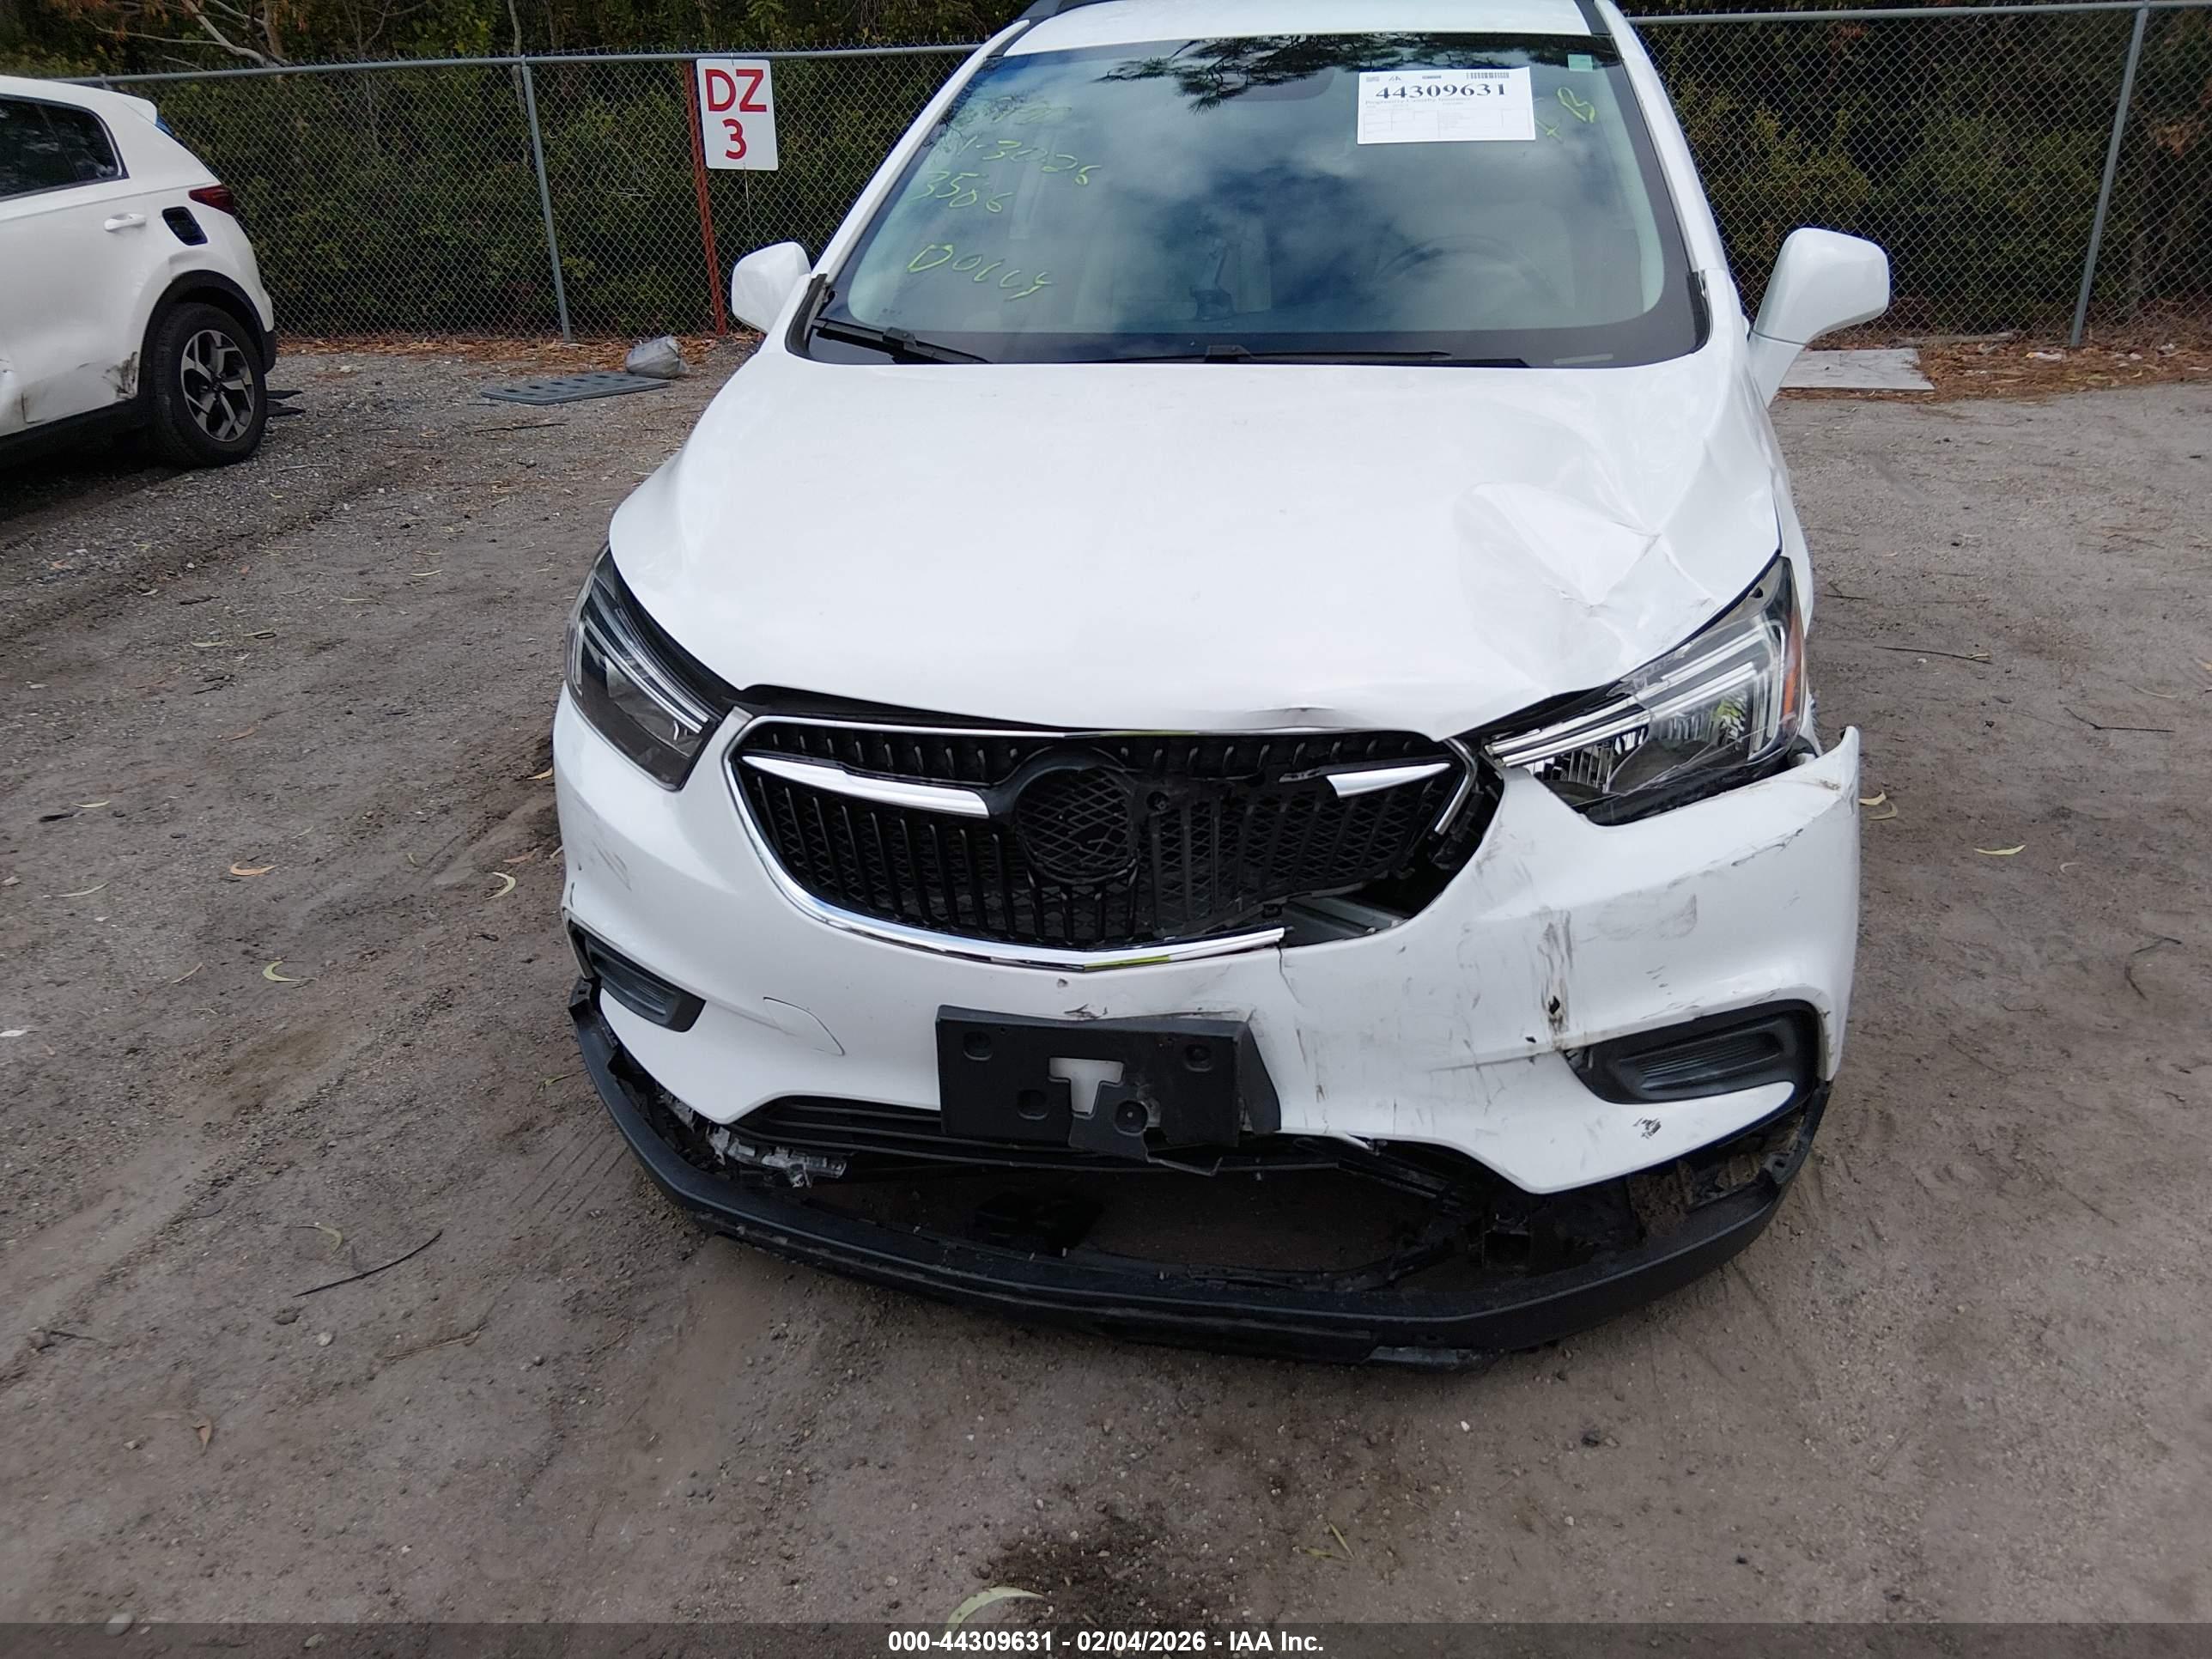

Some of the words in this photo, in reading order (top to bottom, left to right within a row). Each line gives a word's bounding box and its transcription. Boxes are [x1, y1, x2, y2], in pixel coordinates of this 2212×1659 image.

[705, 69, 767, 112] DZ
[1376, 83, 1505, 99] 44309631
[722, 118, 747, 160] 3
